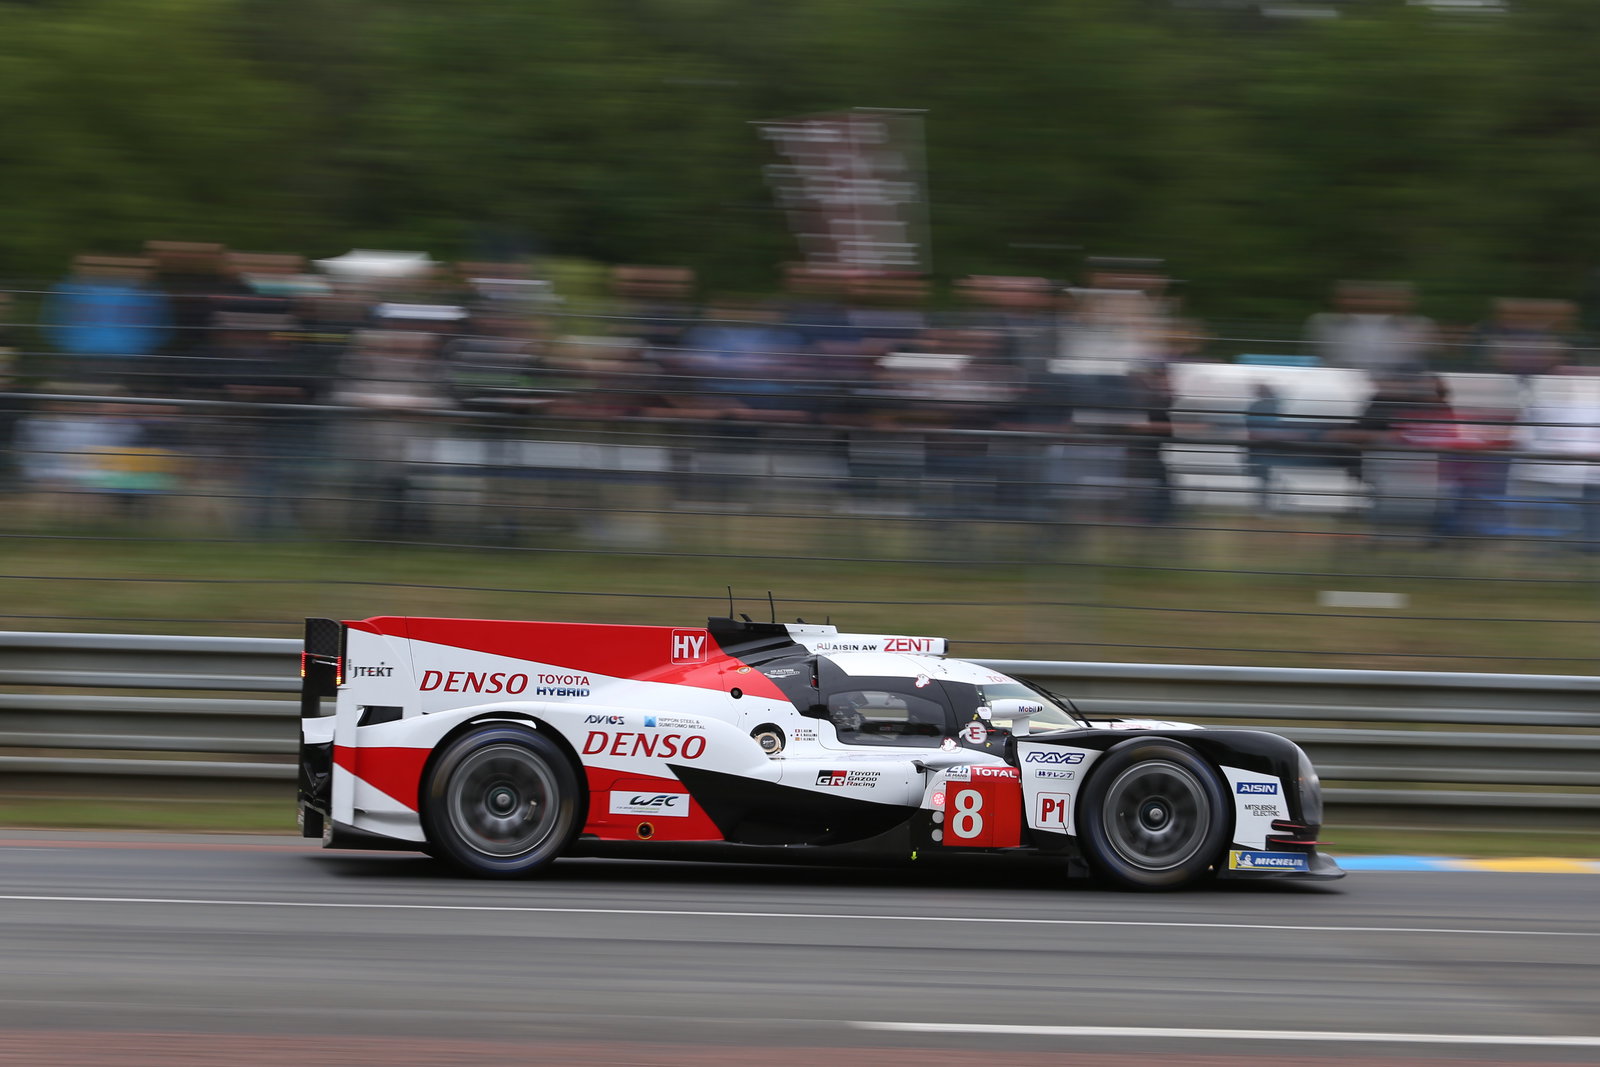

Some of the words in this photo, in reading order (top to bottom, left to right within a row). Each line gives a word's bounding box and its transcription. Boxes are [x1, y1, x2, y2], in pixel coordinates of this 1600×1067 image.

[673, 635, 705, 659] HY
[883, 638, 935, 652] ZENT
[352, 666, 394, 678] JTEKT
[419, 669, 528, 694] DENSO
[537, 674, 590, 686] TOYOTA
[536, 686, 590, 697] HYBRID
[1018, 705, 1037, 713] Mobil
[971, 726, 981, 740] E
[582, 731, 707, 760] DENSO
[1025, 751, 1085, 764] RAYS
[972, 767, 1018, 778] TOTAL
[816, 776, 845, 786] GR
[1239, 783, 1276, 793] AISIN
[629, 795, 679, 807] WEC
[952, 789, 984, 839] 8
[1041, 798, 1065, 823] P1
[1254, 857, 1304, 866] MICHELIN
